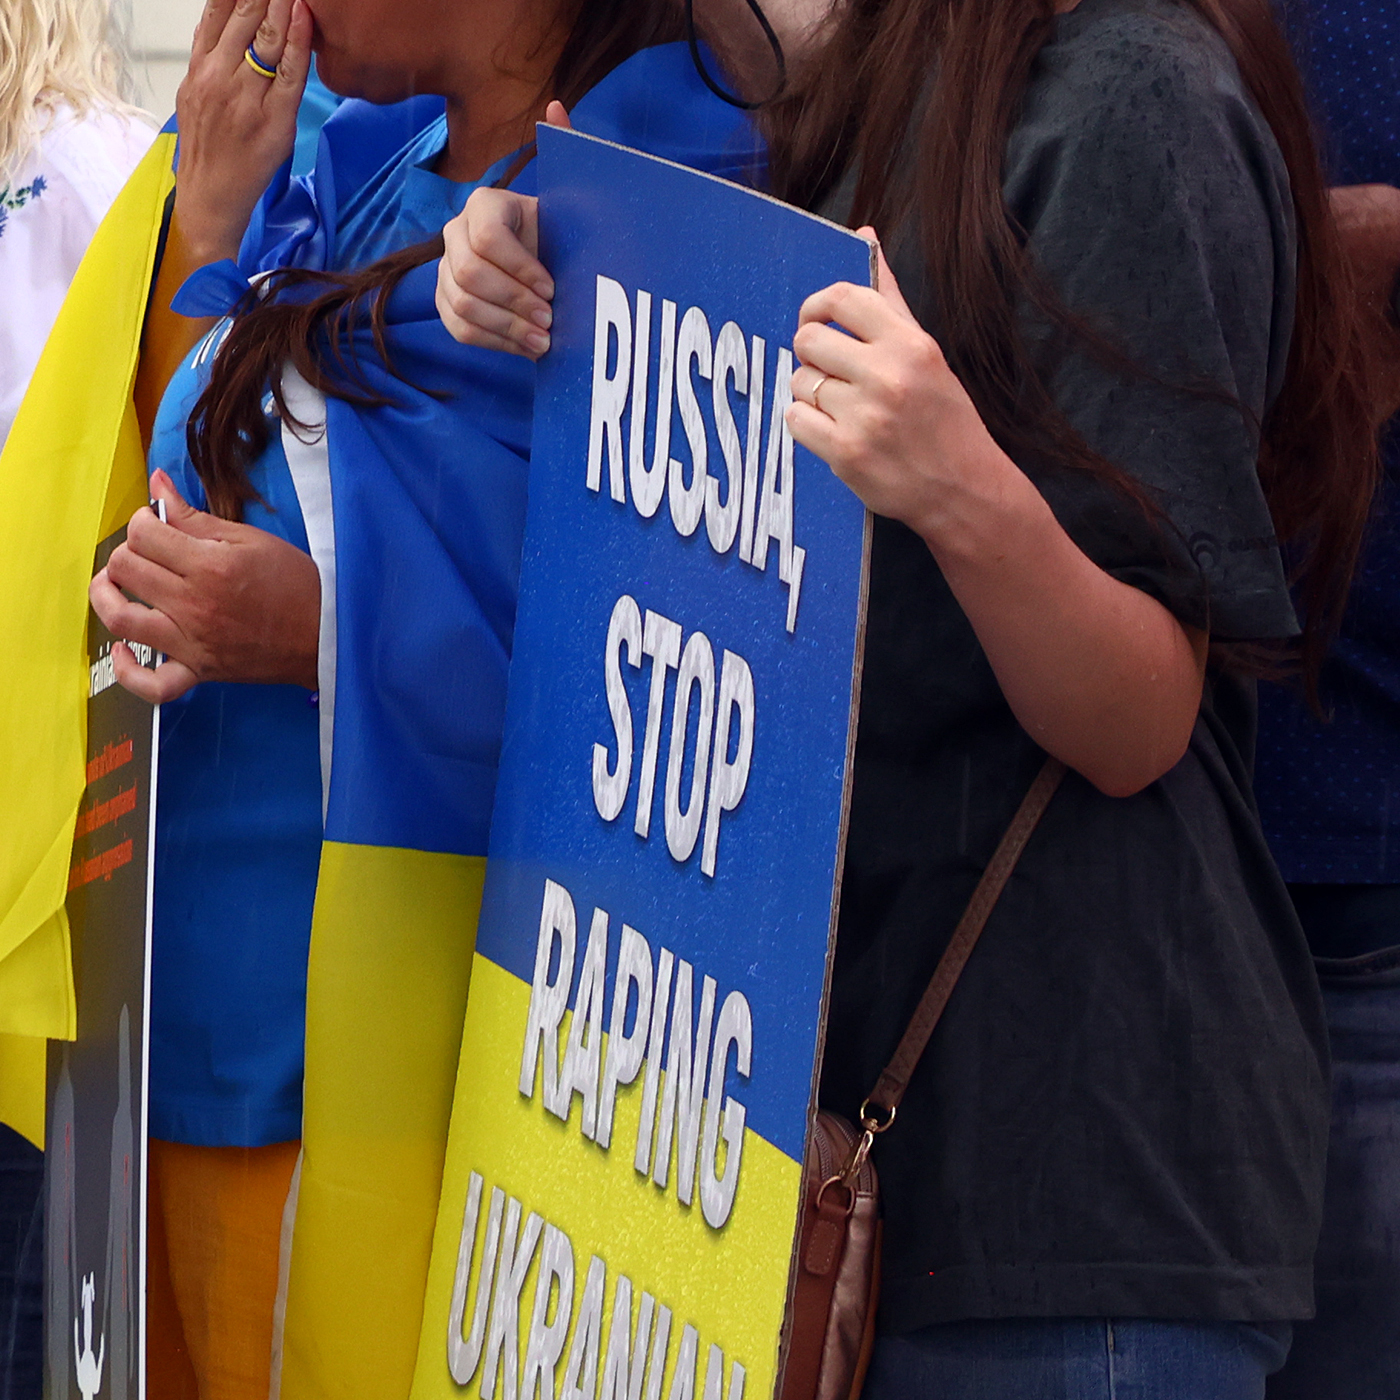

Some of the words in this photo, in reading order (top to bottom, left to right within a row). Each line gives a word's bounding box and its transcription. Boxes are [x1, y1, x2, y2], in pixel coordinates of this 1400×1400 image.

[586, 274, 805, 634] RUSSIA,
[592, 594, 755, 878] STOP
[518, 877, 753, 1229] RAPING
